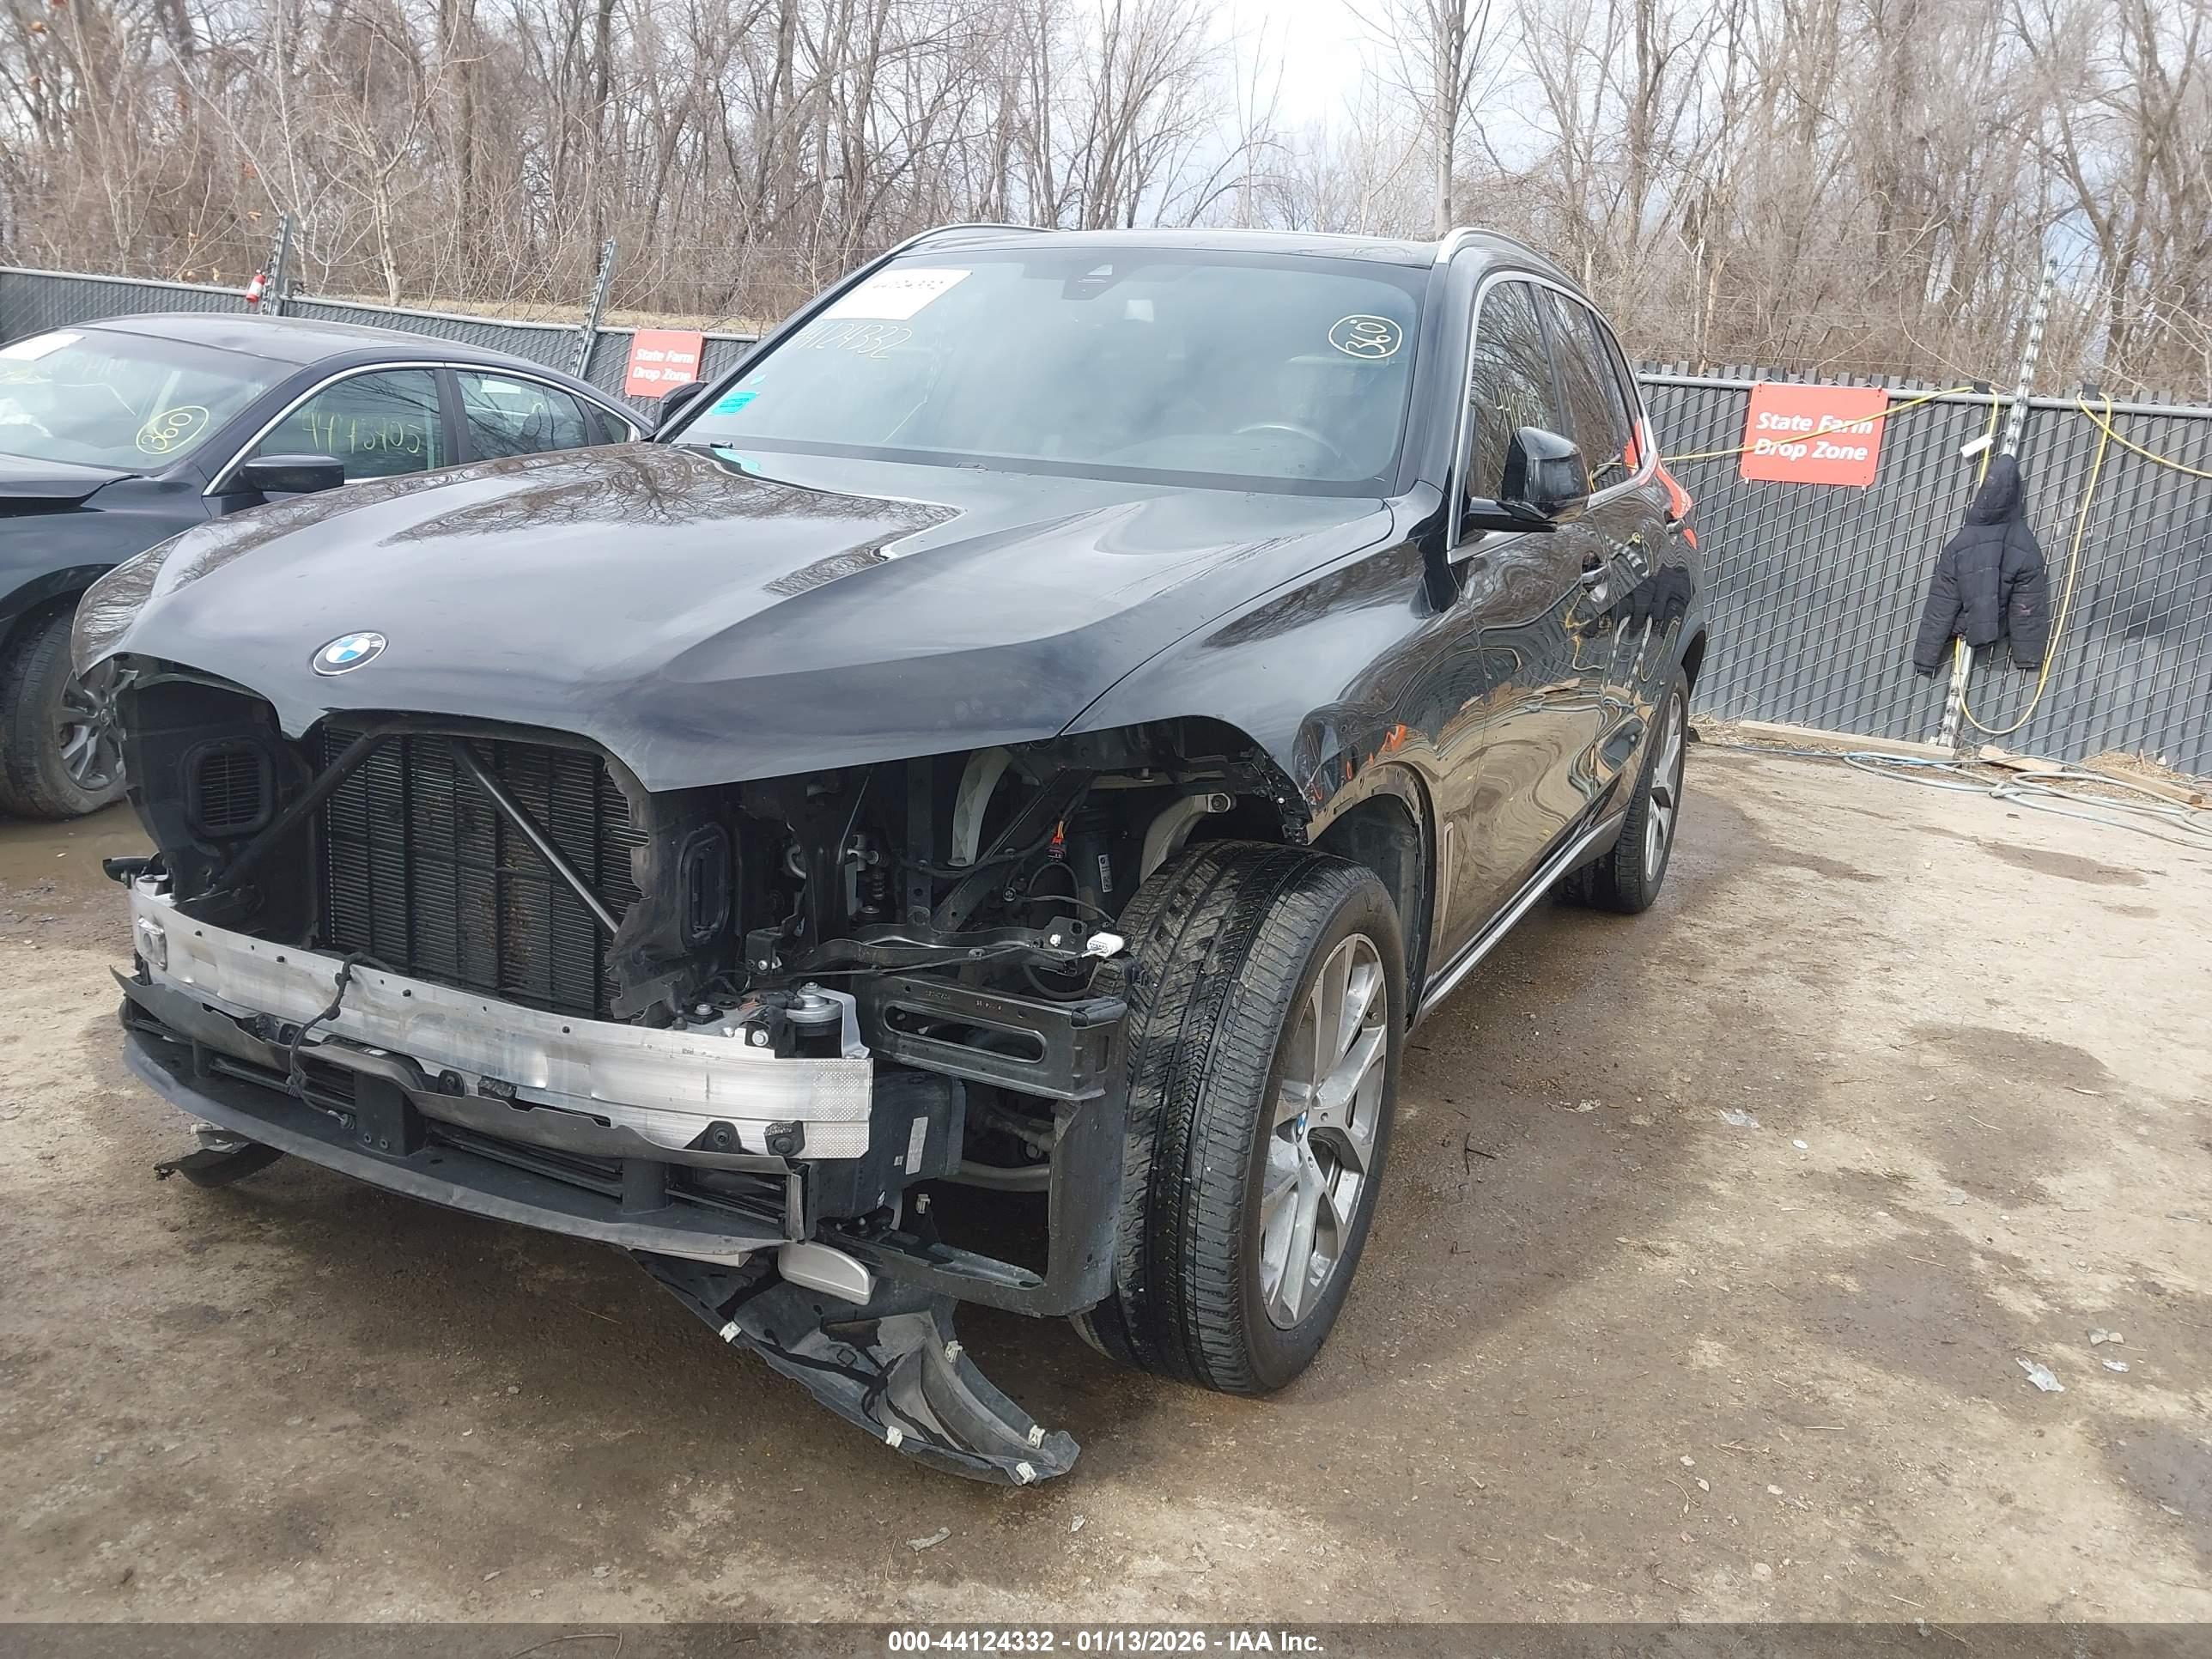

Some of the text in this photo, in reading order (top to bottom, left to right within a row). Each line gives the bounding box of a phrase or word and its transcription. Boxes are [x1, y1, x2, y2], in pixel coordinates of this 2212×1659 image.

[635, 348, 696, 365] State Farm
[632, 366, 692, 383] Drop Zone
[141, 412, 193, 451] 360
[1755, 412, 1874, 434] State Farm
[1753, 438, 1869, 462] Drop Zone
